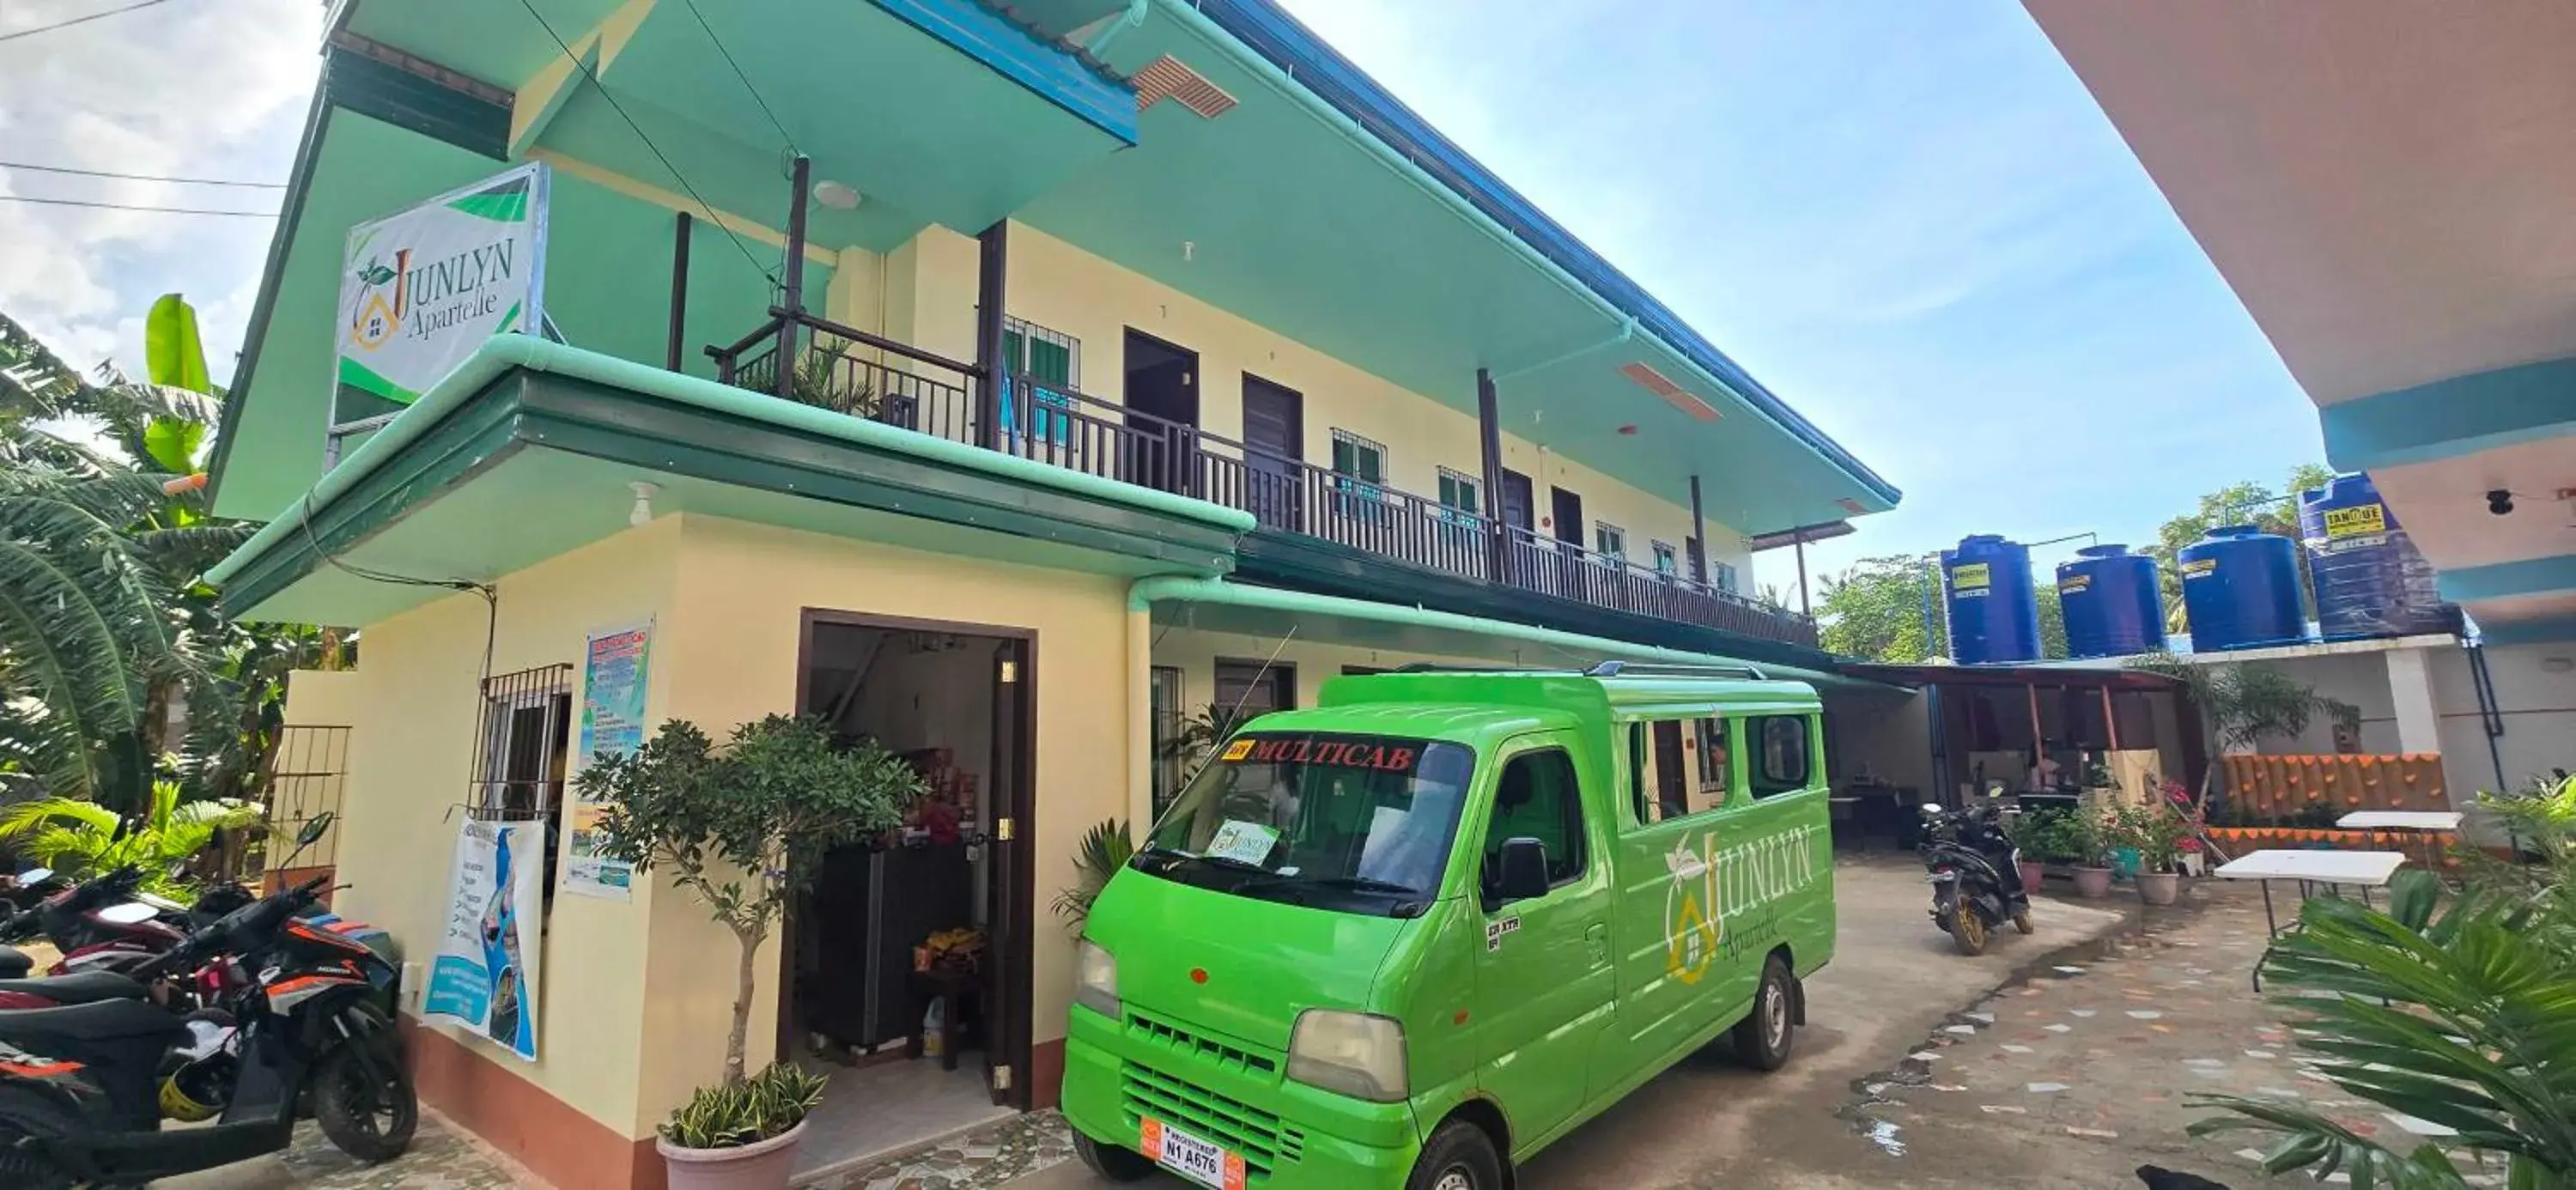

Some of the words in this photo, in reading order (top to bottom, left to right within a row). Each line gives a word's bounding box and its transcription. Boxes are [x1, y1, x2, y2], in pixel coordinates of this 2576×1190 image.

[407, 287, 498, 340] Apartelle
[1252, 740, 1414, 770] MULTICAB
[1166, 1139, 1182, 1160] N1
[1186, 1150, 1217, 1174] A676
